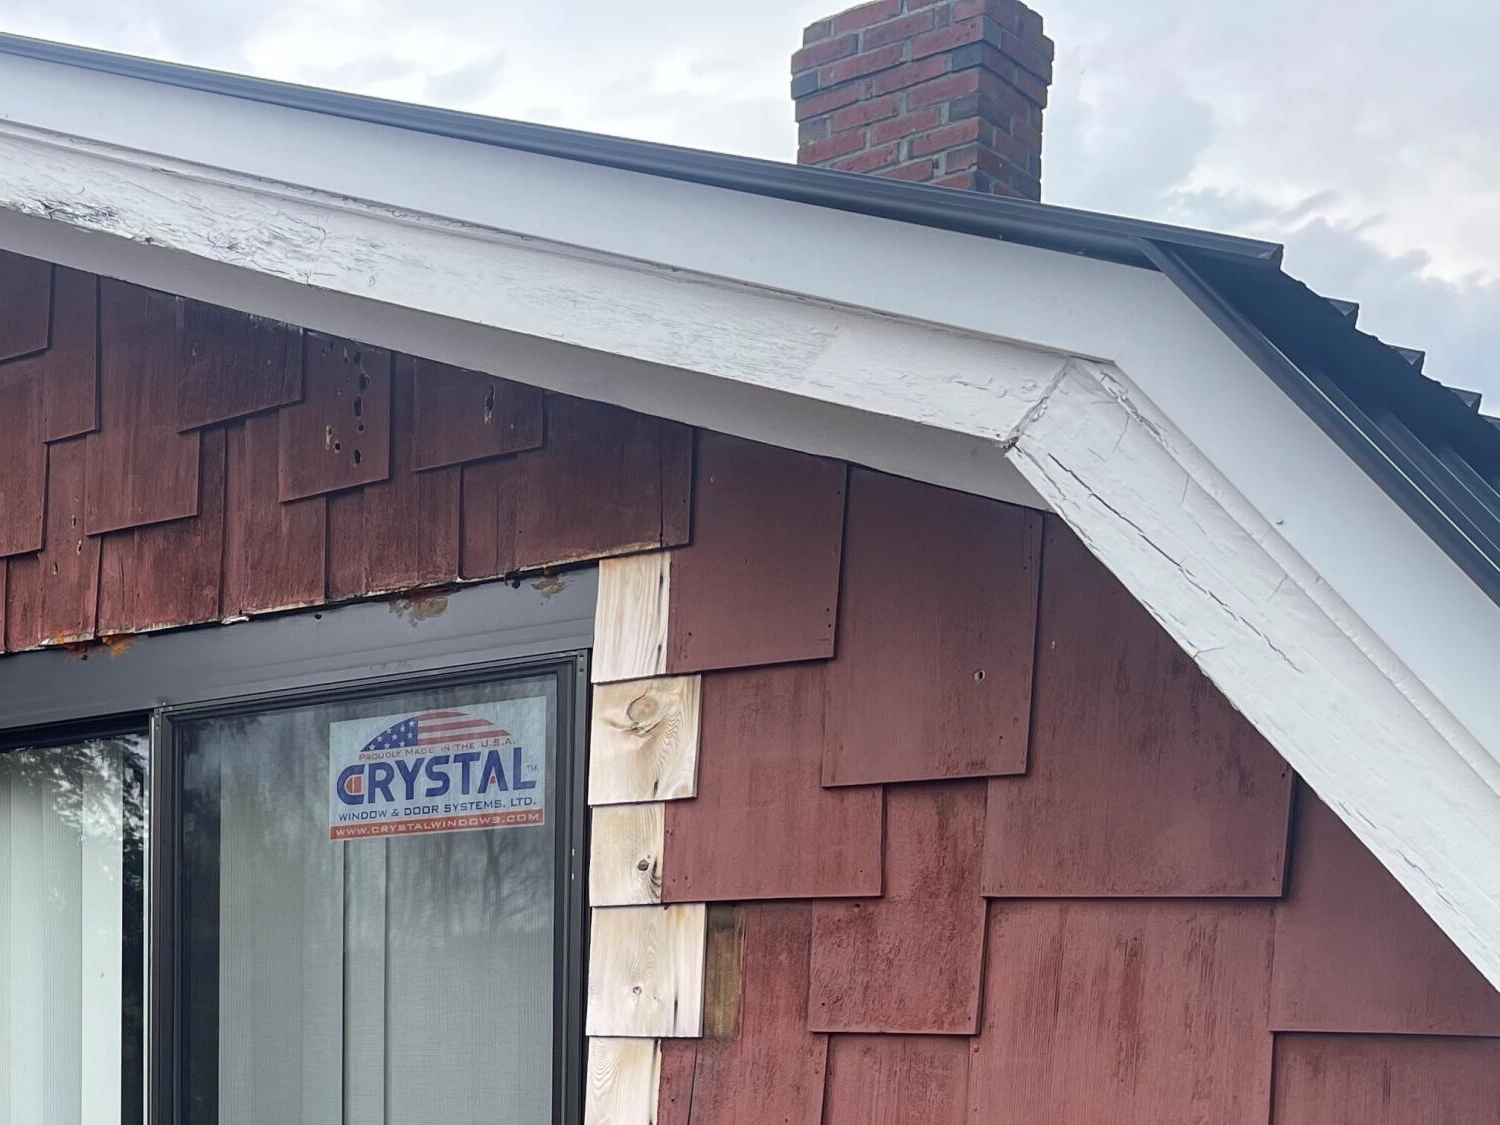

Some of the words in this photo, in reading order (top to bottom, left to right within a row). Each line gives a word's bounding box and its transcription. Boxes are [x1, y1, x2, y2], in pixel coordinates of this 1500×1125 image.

[359, 750, 401, 761] PROUDLY
[405, 747, 434, 757] MADE
[456, 742, 475, 750] THE
[481, 737, 516, 748] U.S.A.
[337, 747, 537, 805] CRYSTAL
[527, 764, 538, 772] TM
[339, 810, 388, 822] WINDOW
[391, 809, 400, 817] &
[404, 805, 440, 816] DOOR
[511, 797, 537, 807] LTD.
